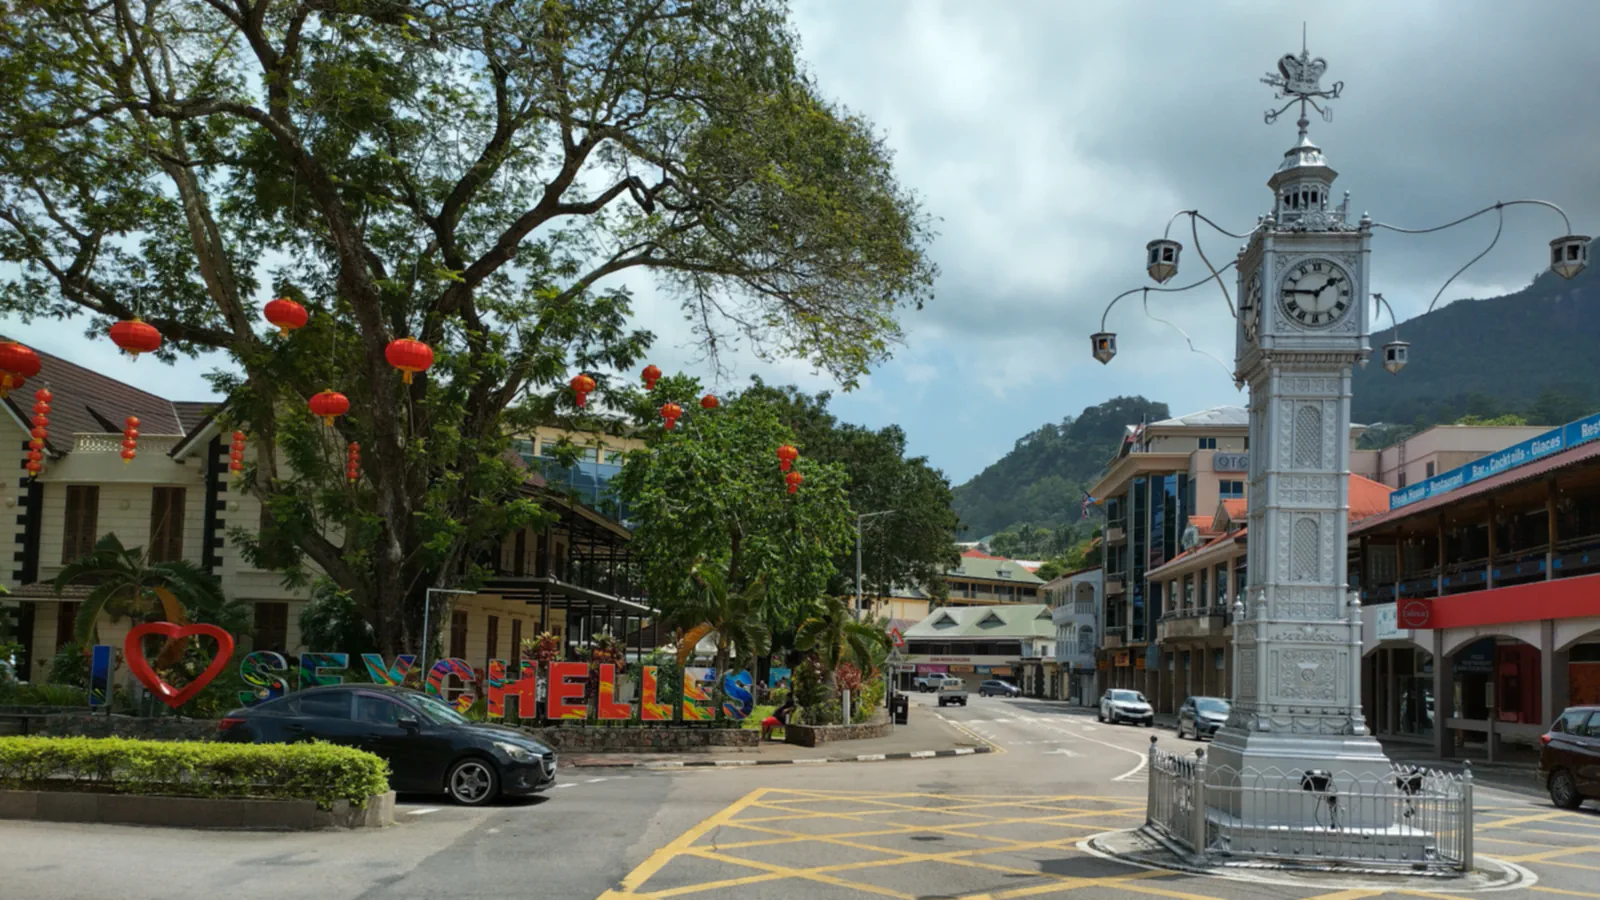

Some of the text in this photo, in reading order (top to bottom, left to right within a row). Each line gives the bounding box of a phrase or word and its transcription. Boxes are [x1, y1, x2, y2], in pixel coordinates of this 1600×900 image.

[1581, 421, 1600, 438] Res
[1472, 465, 1485, 478] Bar
[1490, 449, 1525, 471] Cocktails
[1531, 435, 1560, 456] Glaces
[238, 650, 756, 722] SEYCHELLES
